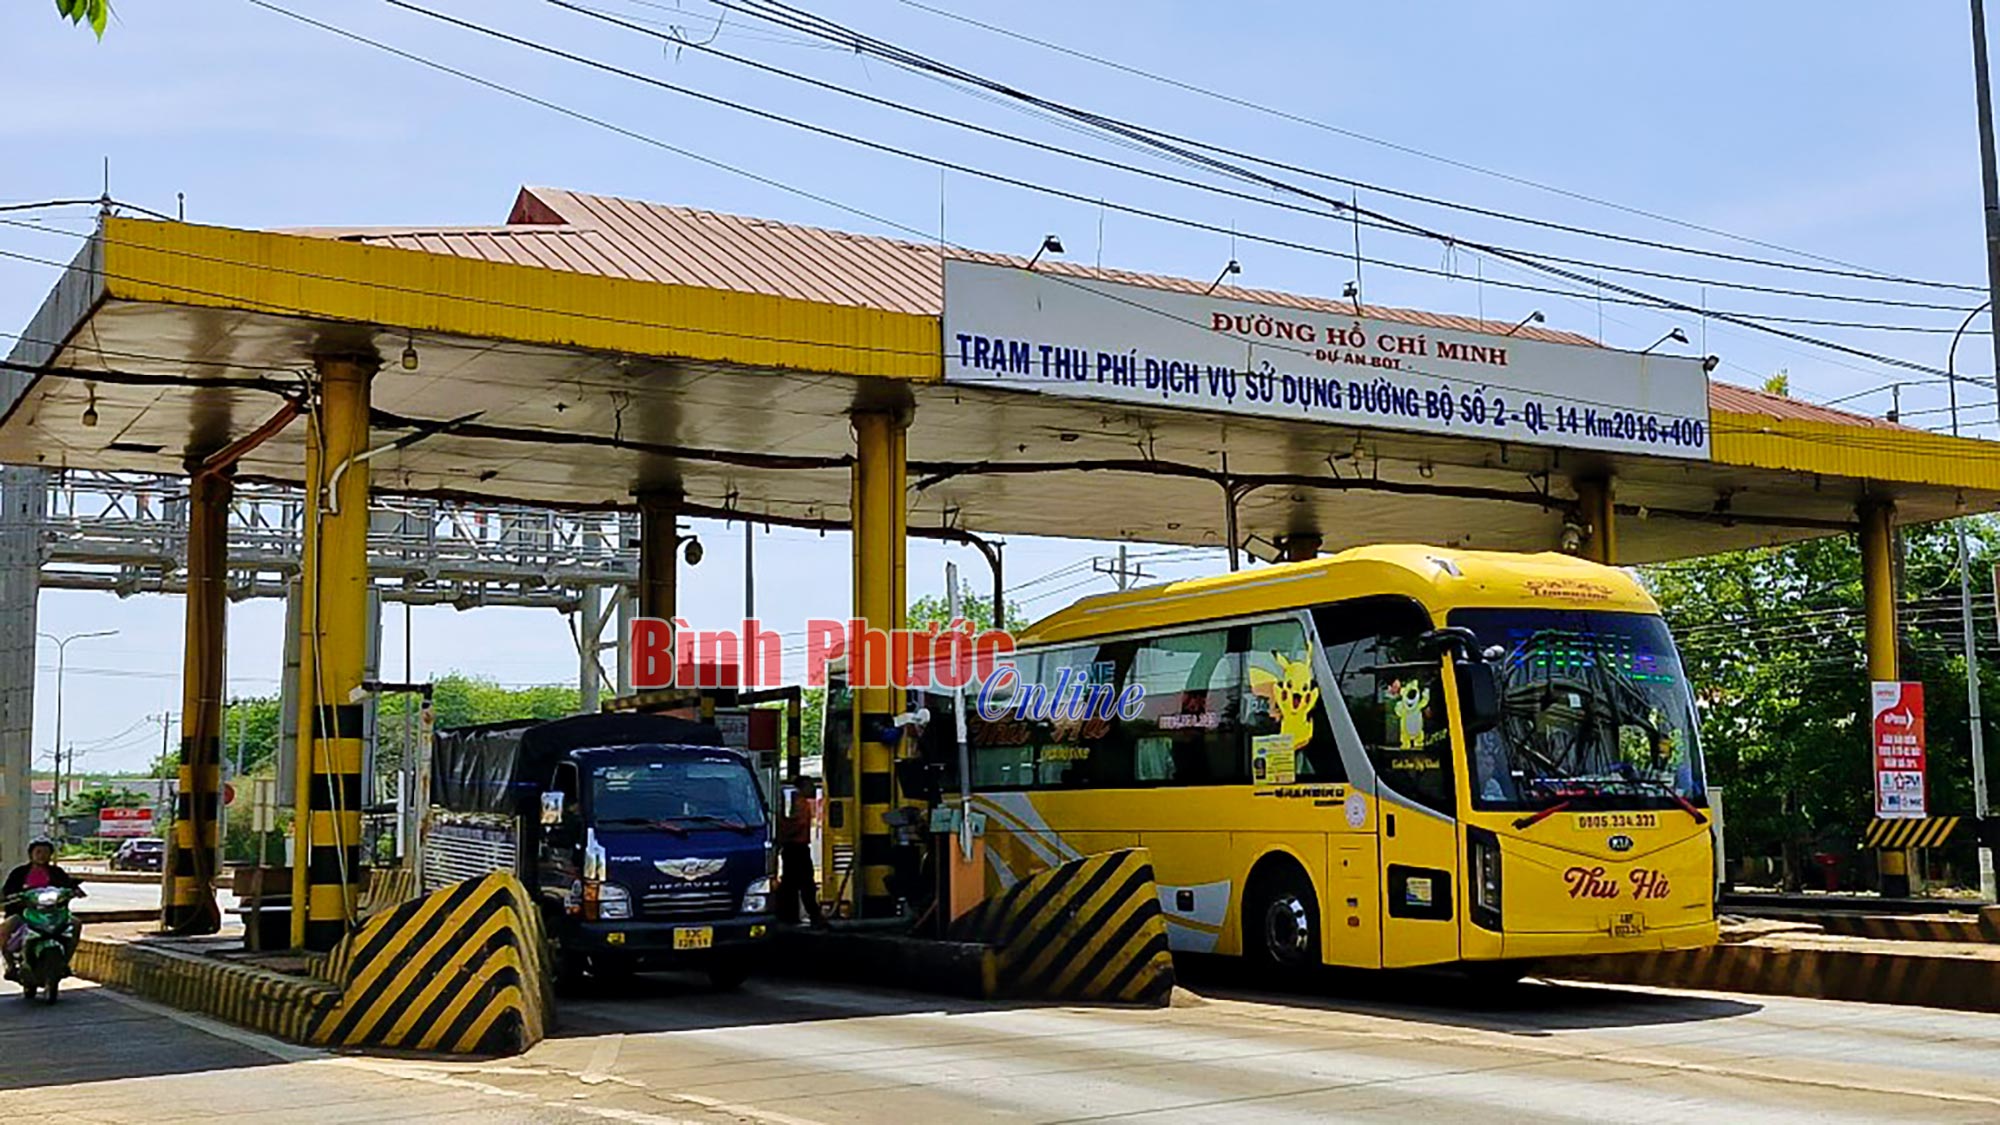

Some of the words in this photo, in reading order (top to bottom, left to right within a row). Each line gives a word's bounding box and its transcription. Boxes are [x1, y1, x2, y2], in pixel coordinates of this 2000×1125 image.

[1212, 313, 1316, 342] ĐƯỜNG
[1326, 321, 1366, 348] HỒ
[1377, 334, 1428, 356] CHÍ
[1436, 341, 1508, 366] MINH
[1371, 356, 1402, 370] BOT
[957, 334, 1030, 377] TRẠM
[1039, 345, 1087, 381] THU
[1098, 348, 1137, 387] PHÍ
[1146, 358, 1198, 398] DỊCH
[1206, 365, 1236, 404] VỤ
[1245, 360, 1276, 403] SỬ
[1282, 375, 1342, 412] DỤNG
[1349, 376, 1419, 417] ĐƯỜNG
[1425, 384, 1454, 426] BỘ
[1461, 385, 1487, 424] SỐ
[1493, 398, 1505, 426] 2
[1524, 401, 1549, 435] QL
[1556, 406, 1578, 434] 14
[1585, 407, 1705, 448] Km2016+400
[1564, 866, 1620, 899] Thu
[1629, 868, 1671, 900] Hà
